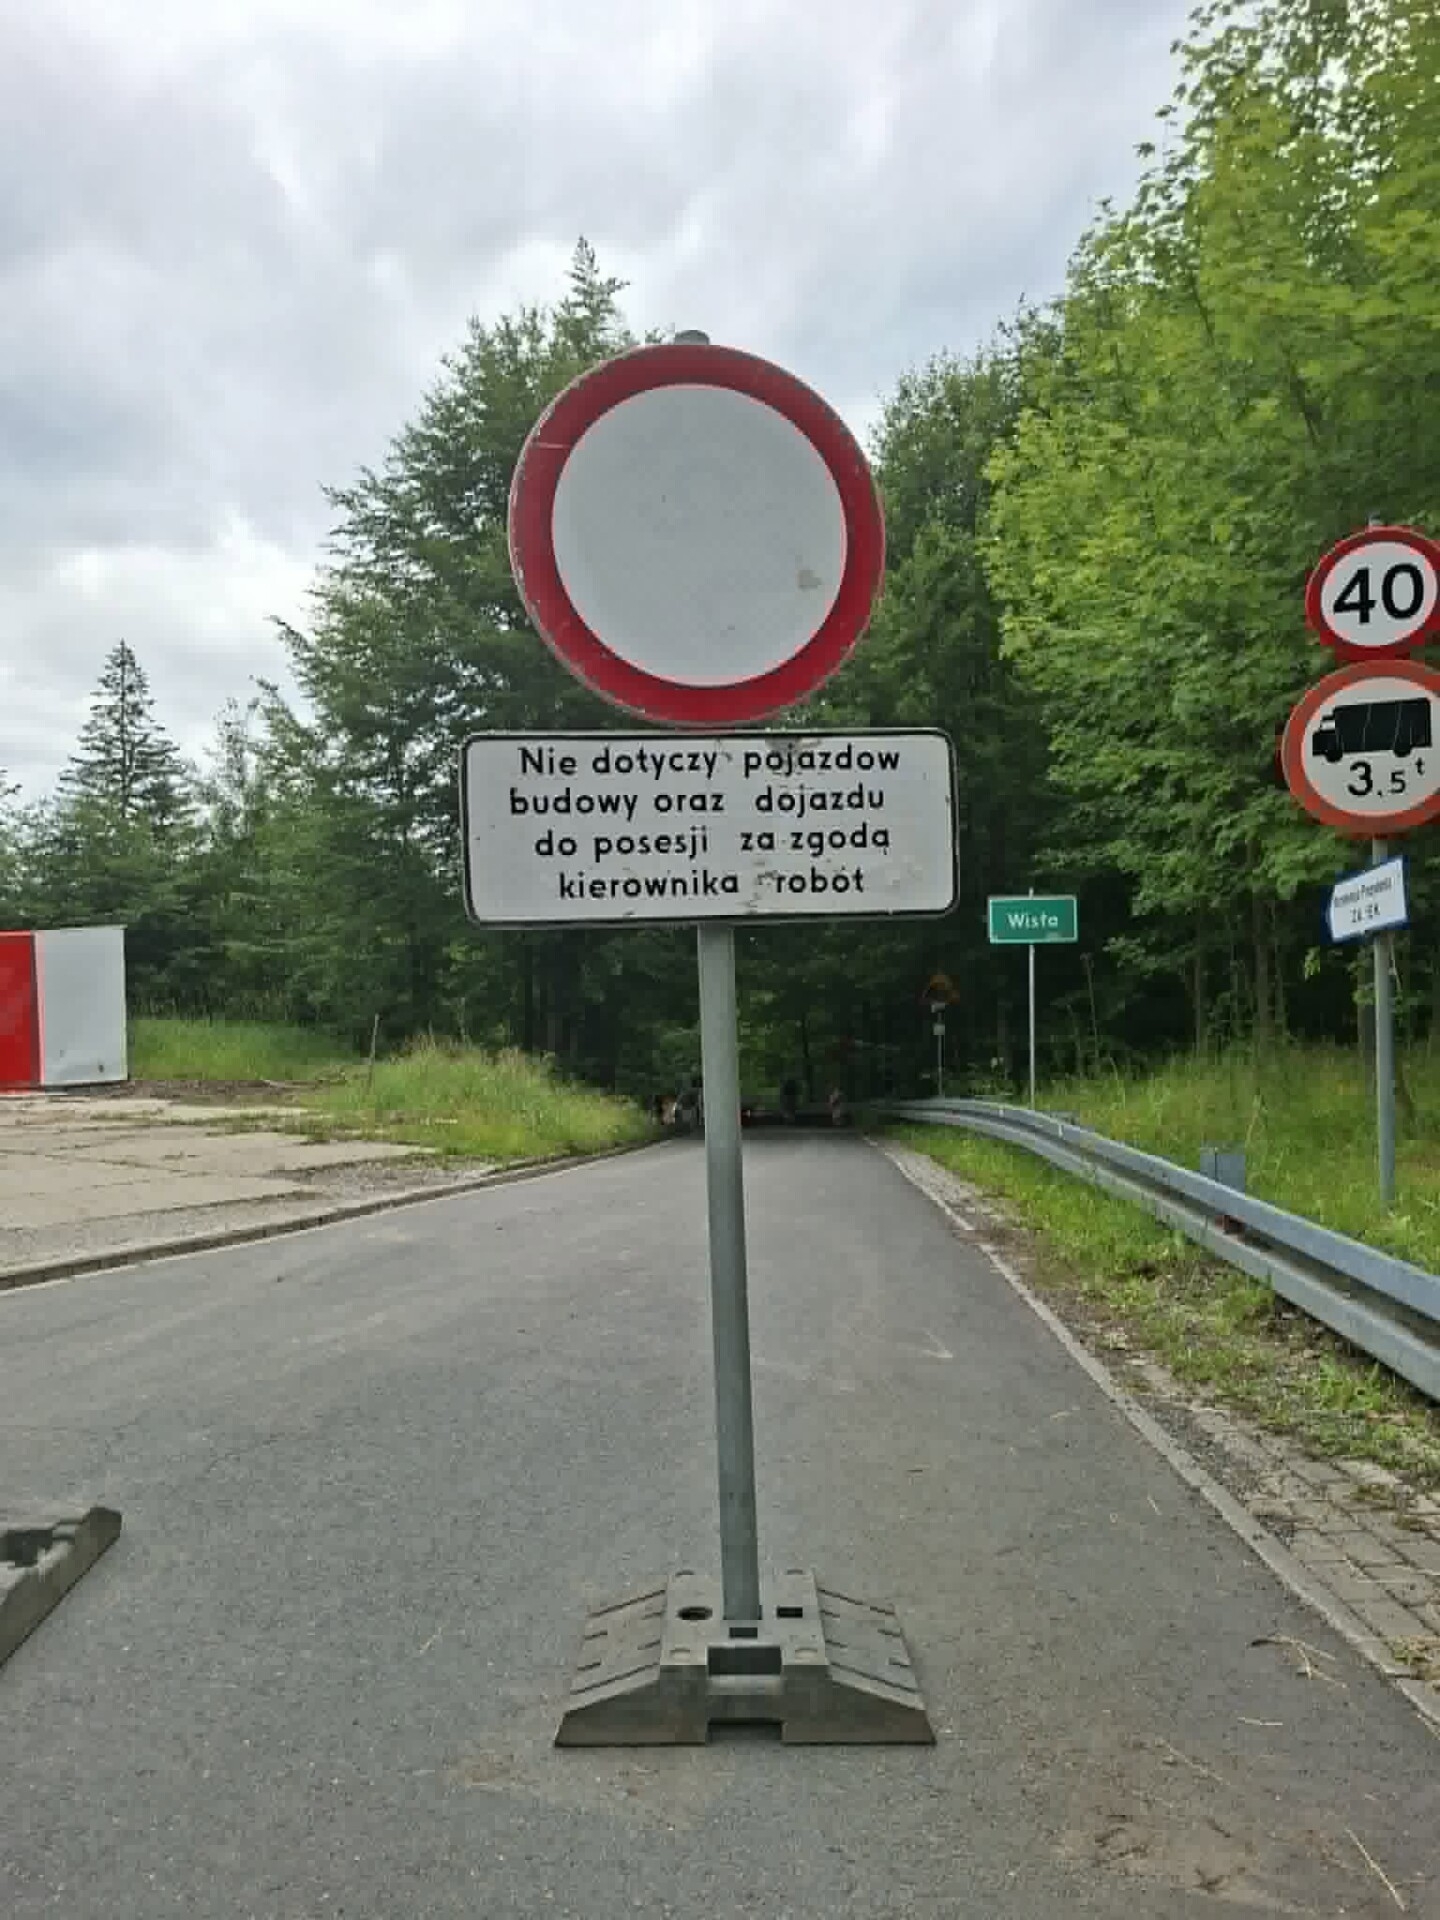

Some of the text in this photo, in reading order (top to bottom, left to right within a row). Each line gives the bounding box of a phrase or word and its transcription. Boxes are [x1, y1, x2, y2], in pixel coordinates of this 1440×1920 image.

[1333, 563, 1425, 624] 40
[518, 742, 900, 781] Nie dotyczy pojazdow
[509, 782, 885, 822] budowy oraz dojazdu
[534, 821, 890, 864] do posesji za zgodą
[559, 869, 740, 899] kierownika
